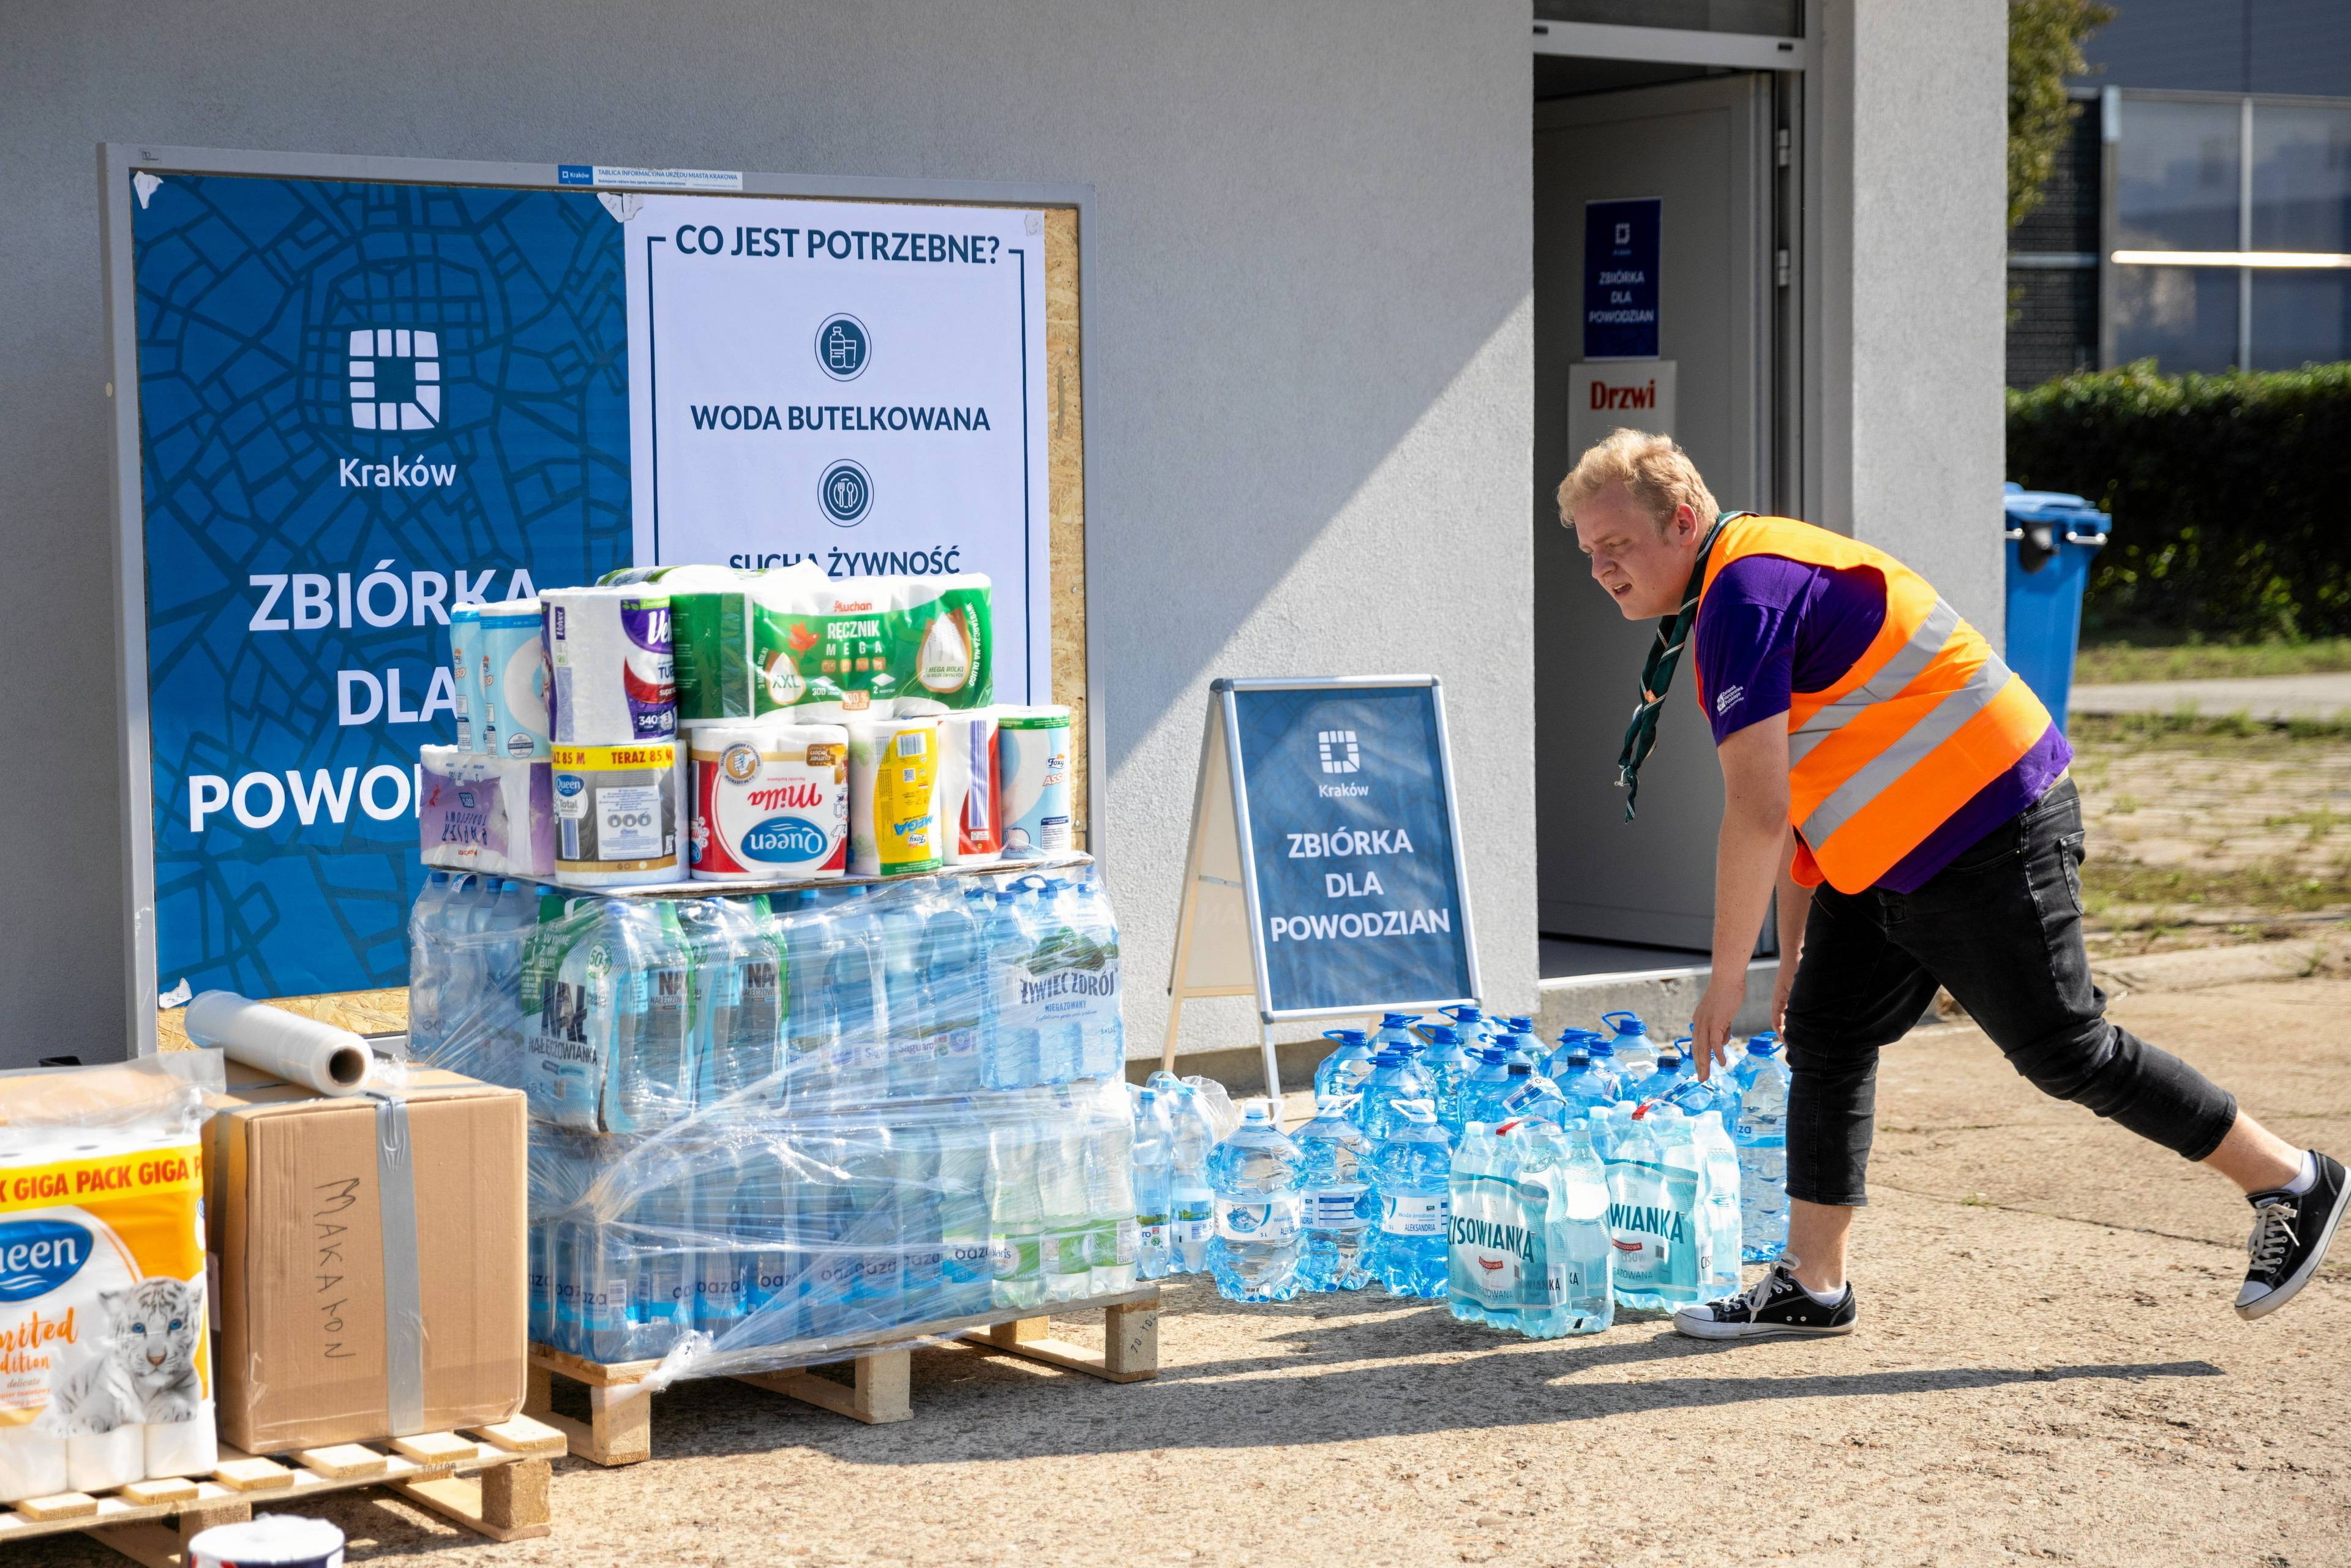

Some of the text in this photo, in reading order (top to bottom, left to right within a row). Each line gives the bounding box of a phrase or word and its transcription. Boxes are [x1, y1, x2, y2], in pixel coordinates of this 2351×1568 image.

[675, 224, 1000, 264] CO JEST POTRZEBNE?
[1599, 271, 1645, 285] ZBIÓRKA
[1611, 291, 1632, 304] DLA
[1589, 310, 1654, 323] POWODZIAN
[1590, 380, 1657, 410] Drzwi
[691, 405, 991, 432] WODA BUTELKOWANA
[339, 454, 457, 488] Kraków
[827, 544, 961, 577] ŻYWNOŚĆ
[834, 600, 872, 612] Auchan
[827, 620, 880, 642] RĘCZNIK
[758, 647, 769, 665] ROLKI
[827, 641, 882, 656] MEGA
[973, 648, 981, 660] NA
[772, 675, 801, 688] XXL
[969, 661, 980, 687] DŁUGO
[337, 666, 458, 726] DLA
[1722, 685, 1736, 696] Związek
[1724, 686, 1744, 700] Harcerstwa
[1725, 692, 1741, 705] Polskiego
[639, 715, 658, 725] 340
[563, 752, 572, 764] 85
[576, 752, 585, 764] M
[612, 749, 672, 764] TERAZ 85 M
[1048, 759, 1064, 768] Foxy
[556, 778, 581, 790] Queen
[1319, 782, 1369, 798] Kraków
[559, 799, 578, 809] Total
[748, 782, 823, 811] Milla
[445, 811, 487, 827] TOALETOWY
[894, 815, 933, 836] MEGA
[441, 823, 488, 846] PAPIER
[749, 827, 823, 853] Queen
[909, 835, 926, 844] Foxy
[1287, 827, 1414, 858] ZBIÓRKA
[1325, 871, 1384, 898] DLA
[1270, 908, 1450, 942] POWODZIAN
[1020, 970, 1115, 1004] ŻYWIEC ZDRÓJ
[1044, 1000, 1087, 1012] NIEGAZOWANY
[528, 1036, 598, 1066] NAŁĘCZOWIANKA
[898, 1041, 934, 1052] Saguaro
[13, 1174, 69, 1201] GIGA
[77, 1165, 132, 1194] PACK
[138, 1158, 189, 1185] GIGA
[1447, 1215, 1534, 1263] CISOWIANKA
[697, 1280, 740, 1294] oaza
[1471, 1282, 1513, 1299] NIEGAZOWANA
[7, 1379, 40, 1389] delicate
[17, 1387, 51, 1397] toaletowy
